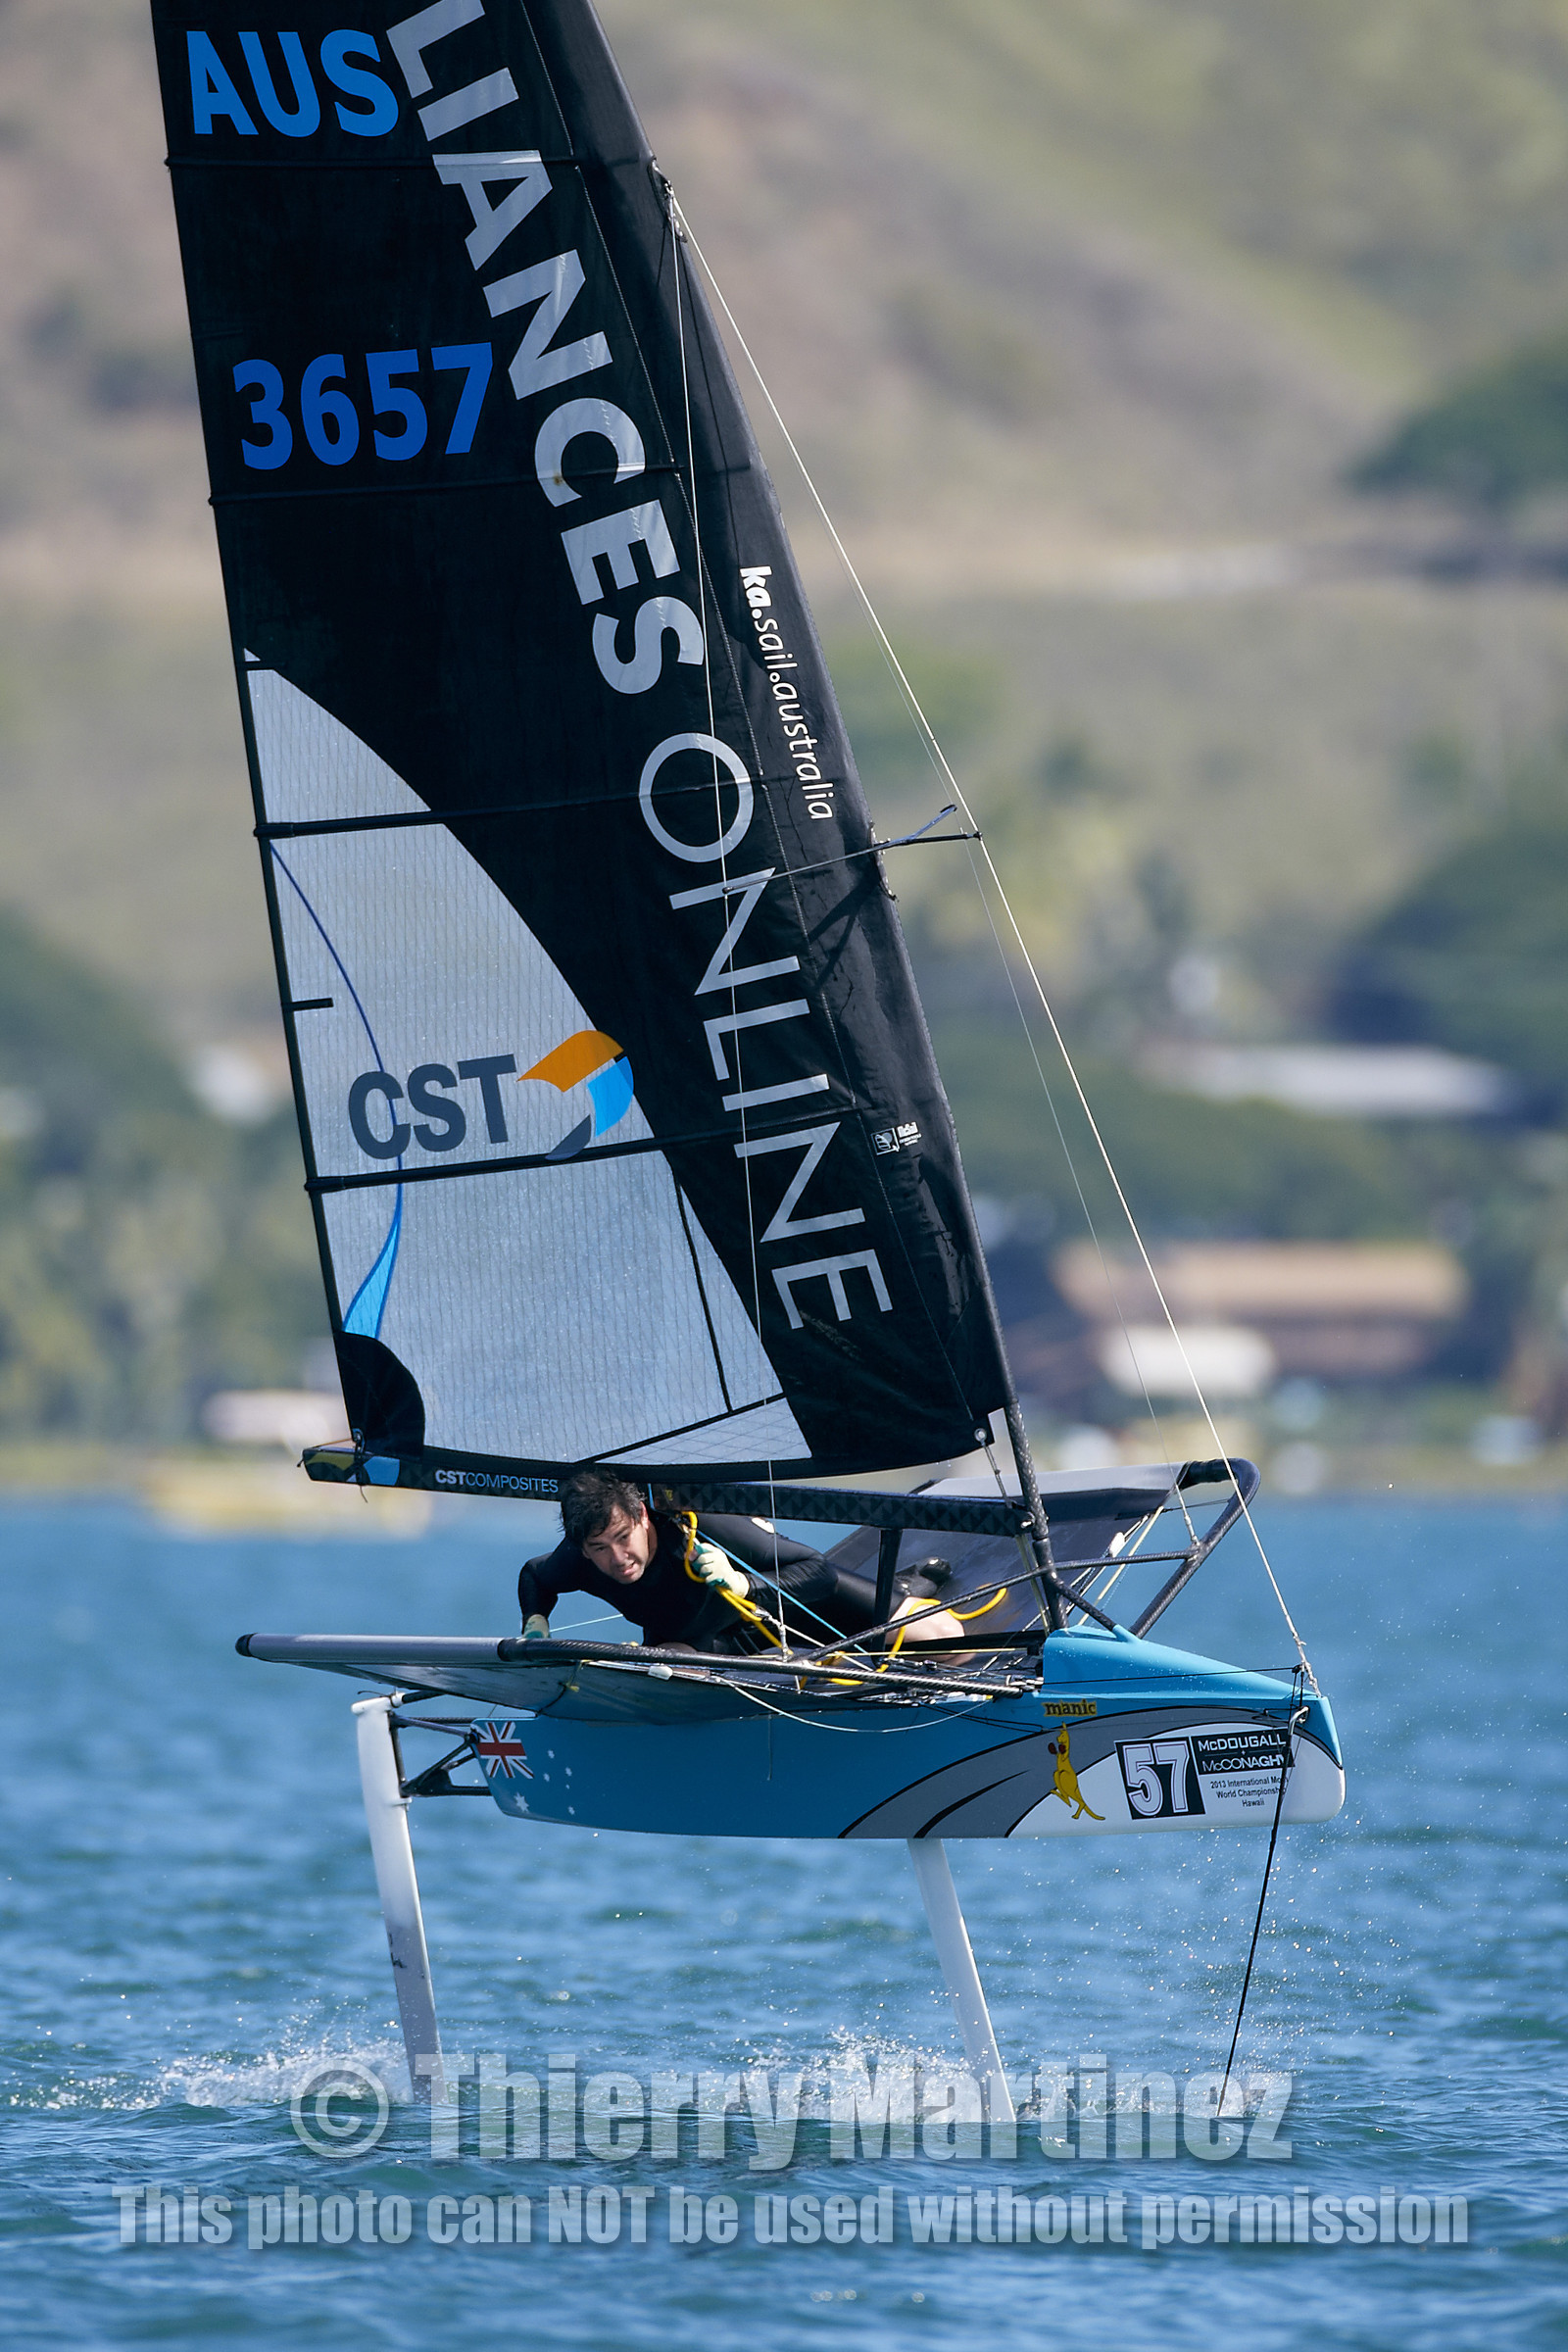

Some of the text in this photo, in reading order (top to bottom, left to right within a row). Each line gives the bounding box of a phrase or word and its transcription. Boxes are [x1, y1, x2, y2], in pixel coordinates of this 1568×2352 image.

[186, 28, 399, 137] AUS
[232, 342, 493, 470] 3657
[639, 732, 893, 1330] ONLINE
[348, 1054, 517, 1159] CST
[1044, 1698, 1097, 1715] manic
[1198, 1734, 1286, 1751] McDOUGALL
[1122, 1740, 1191, 1816] 57
[1216, 1787, 1287, 1798] World Championshp
[1228, 1777, 1269, 1788] International
[1242, 1798, 1265, 1807] Hawaii
